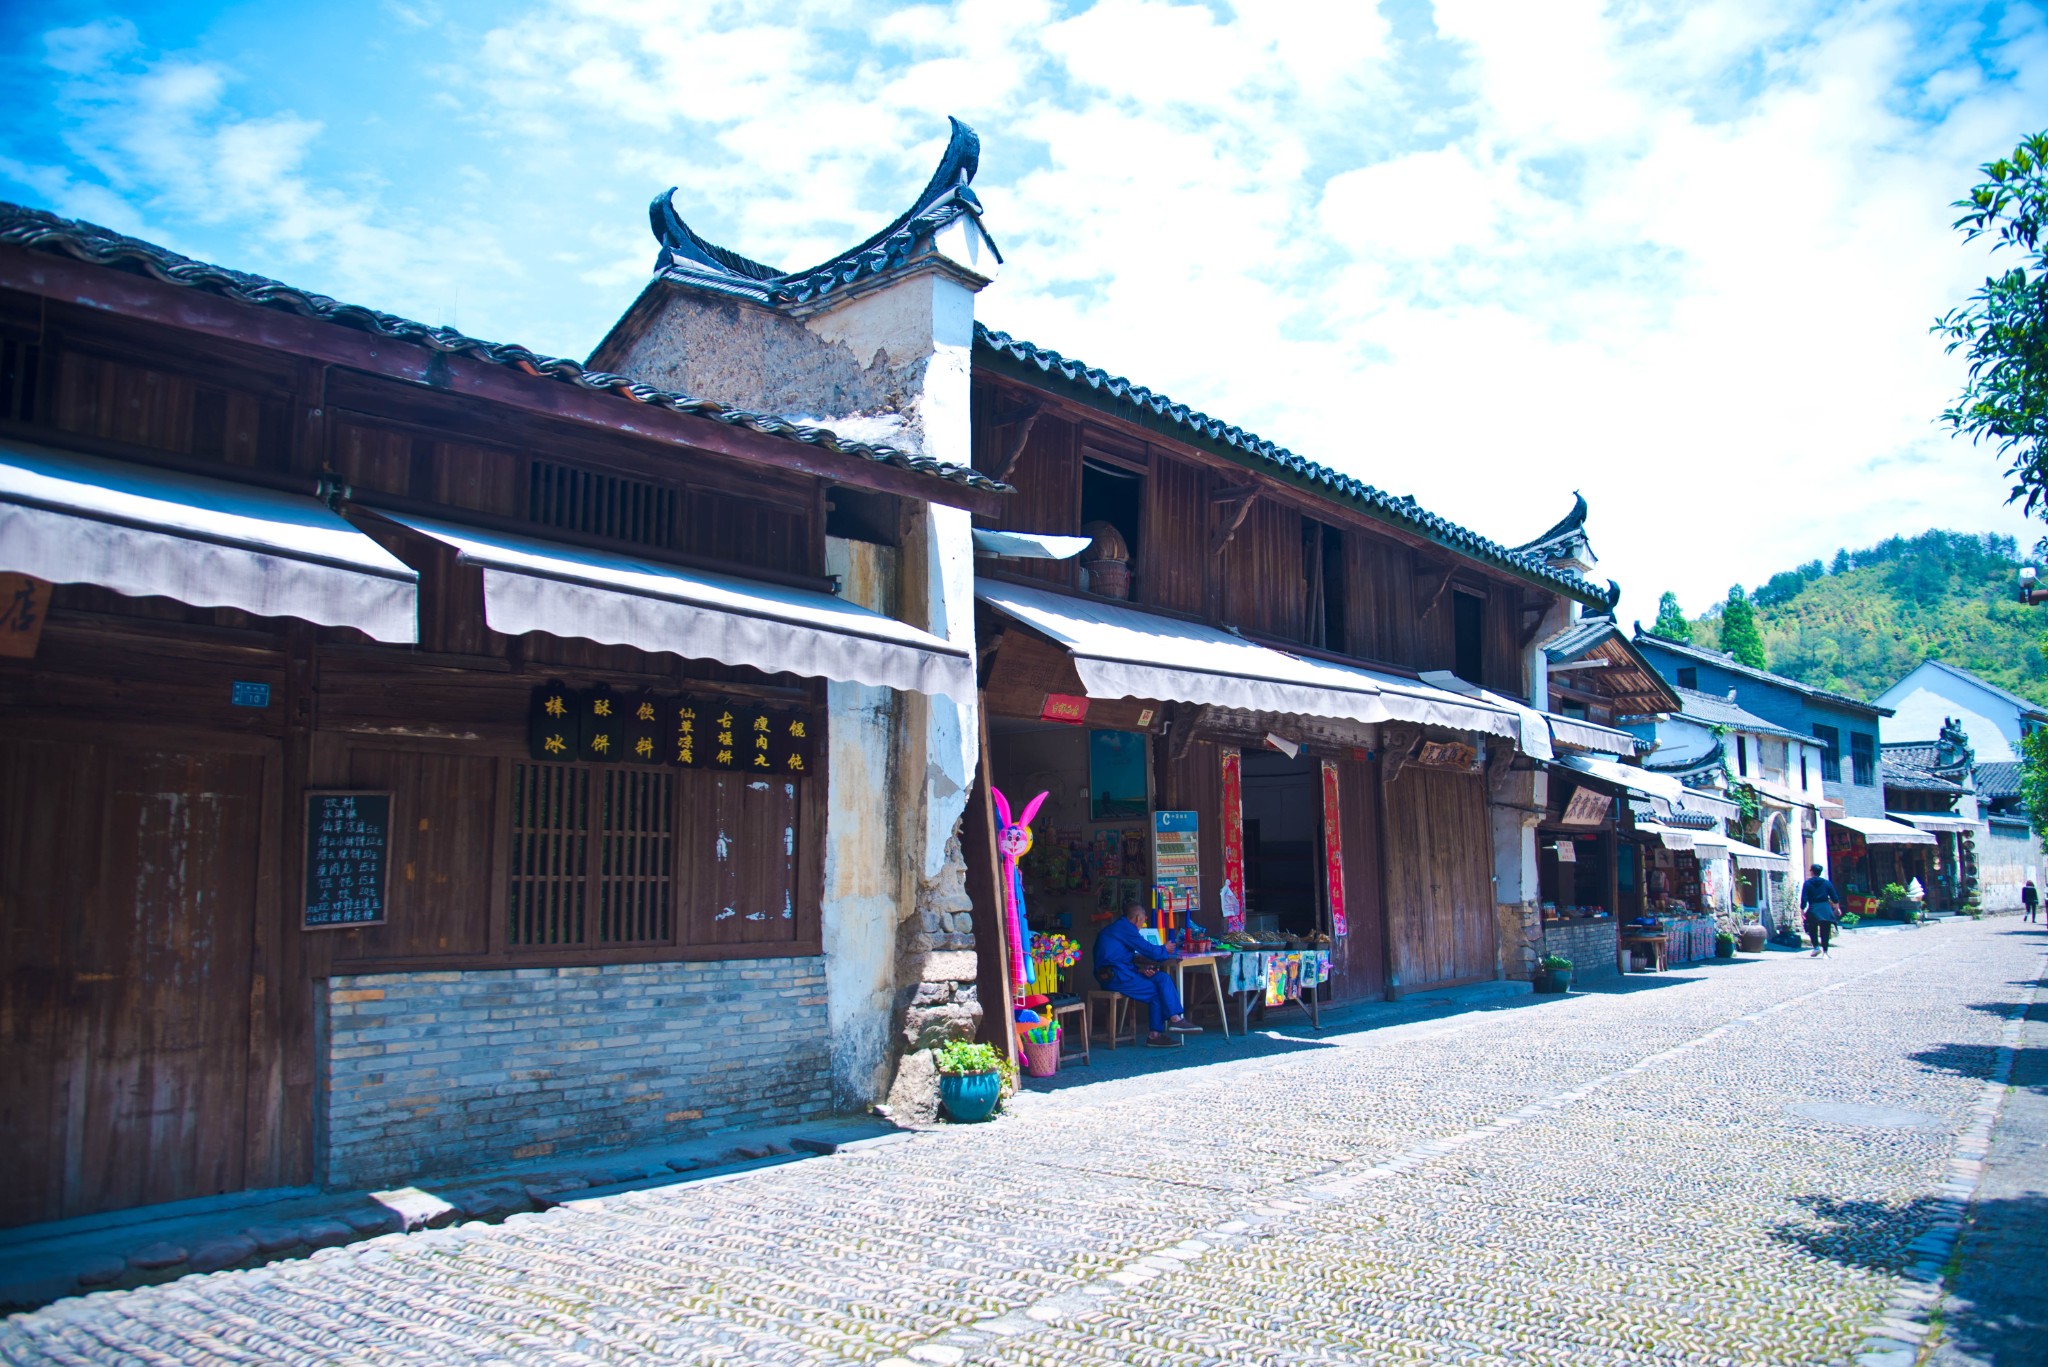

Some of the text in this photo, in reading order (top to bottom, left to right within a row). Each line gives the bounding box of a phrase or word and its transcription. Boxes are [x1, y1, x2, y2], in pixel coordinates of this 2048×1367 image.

[0, 579, 36, 631] 店
[544, 695, 568, 755] 棒冰
[591, 698, 613, 755] 酥饼
[635, 702, 656, 759] 饮料
[715, 712, 734, 765] 古堰饼
[753, 715, 771, 767] 瘦肉丸
[787, 719, 807, 771] 馄饨
[322, 796, 355, 809] 饮料
